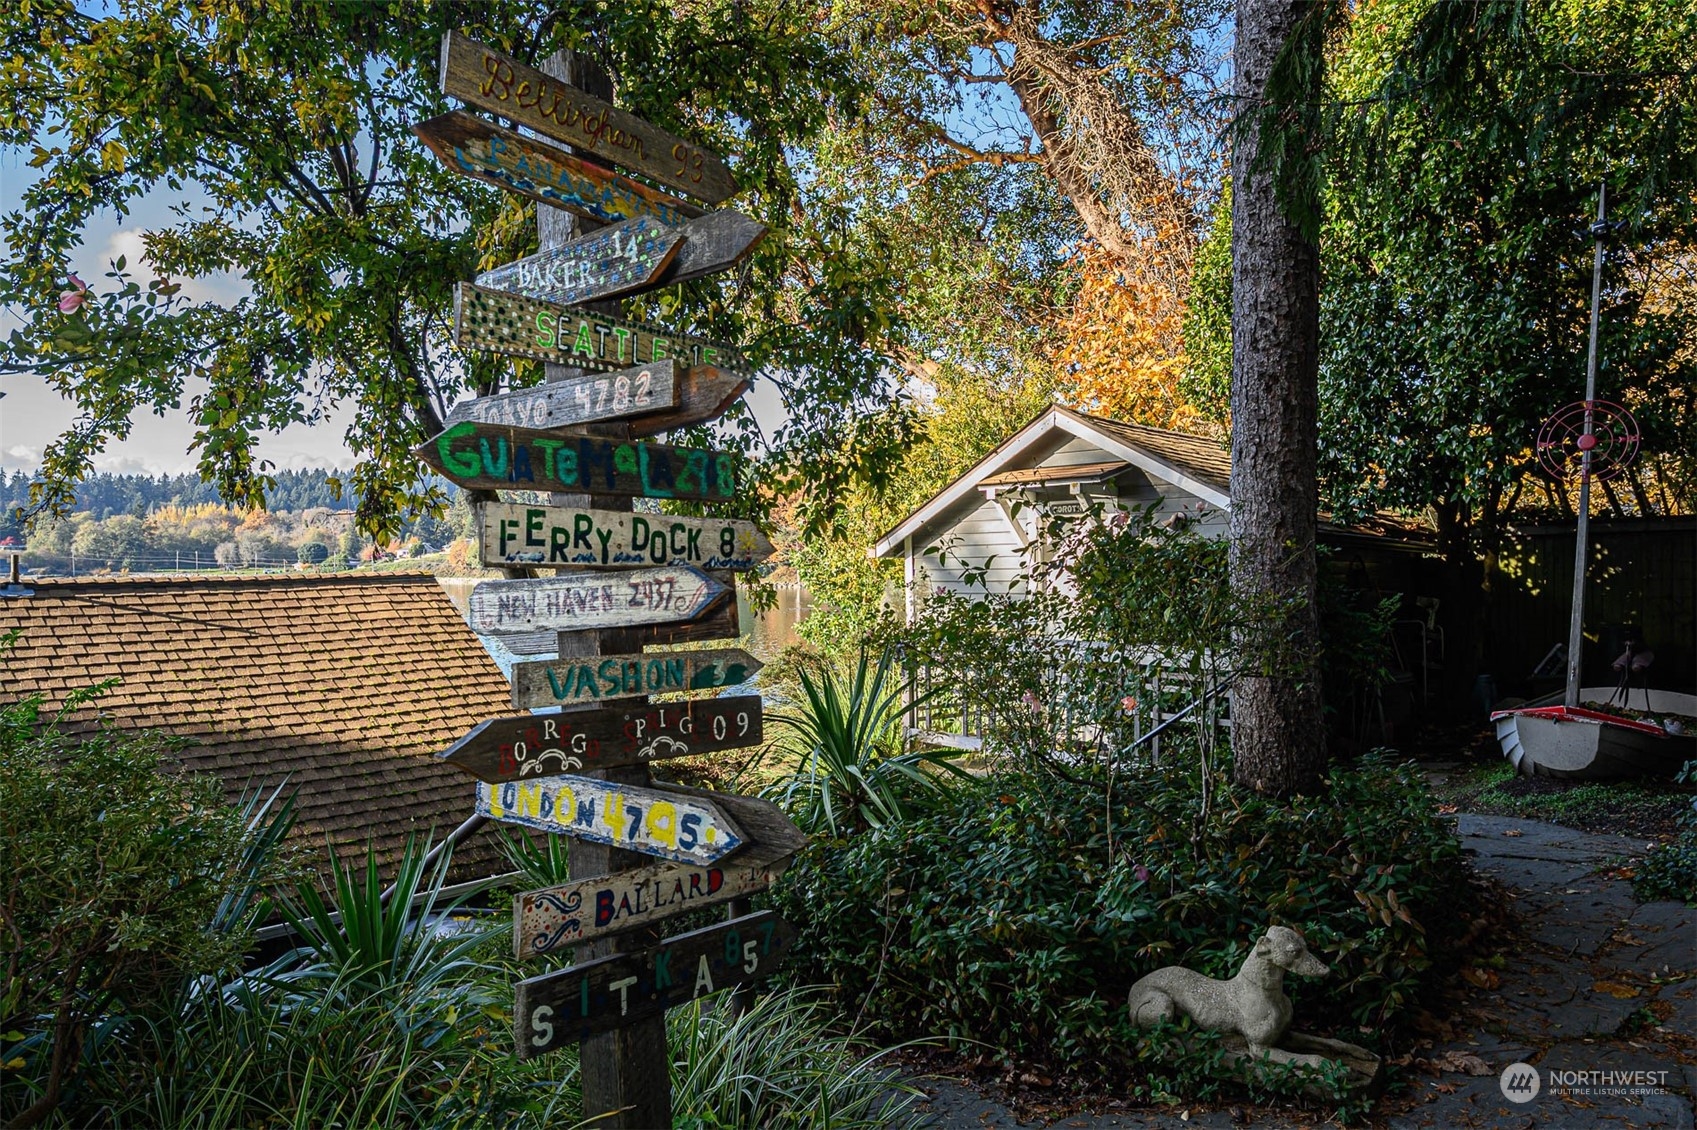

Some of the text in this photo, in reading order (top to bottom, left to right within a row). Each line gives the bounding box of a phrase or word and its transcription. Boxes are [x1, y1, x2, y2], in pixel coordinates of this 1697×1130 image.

[478, 51, 704, 184] Bellingham 93
[517, 258, 597, 291] BAKER
[535, 311, 670, 366] SEATTLE
[574, 370, 652, 415] 4782
[499, 508, 736, 565] FERRY DOCK 8
[498, 592, 537, 623] NEW
[546, 585, 615, 618] HAVEN
[546, 658, 686, 701] VASHON
[488, 781, 596, 828] LONDON
[594, 867, 725, 928] BALLARD
[531, 919, 776, 1047] SITKA 857
